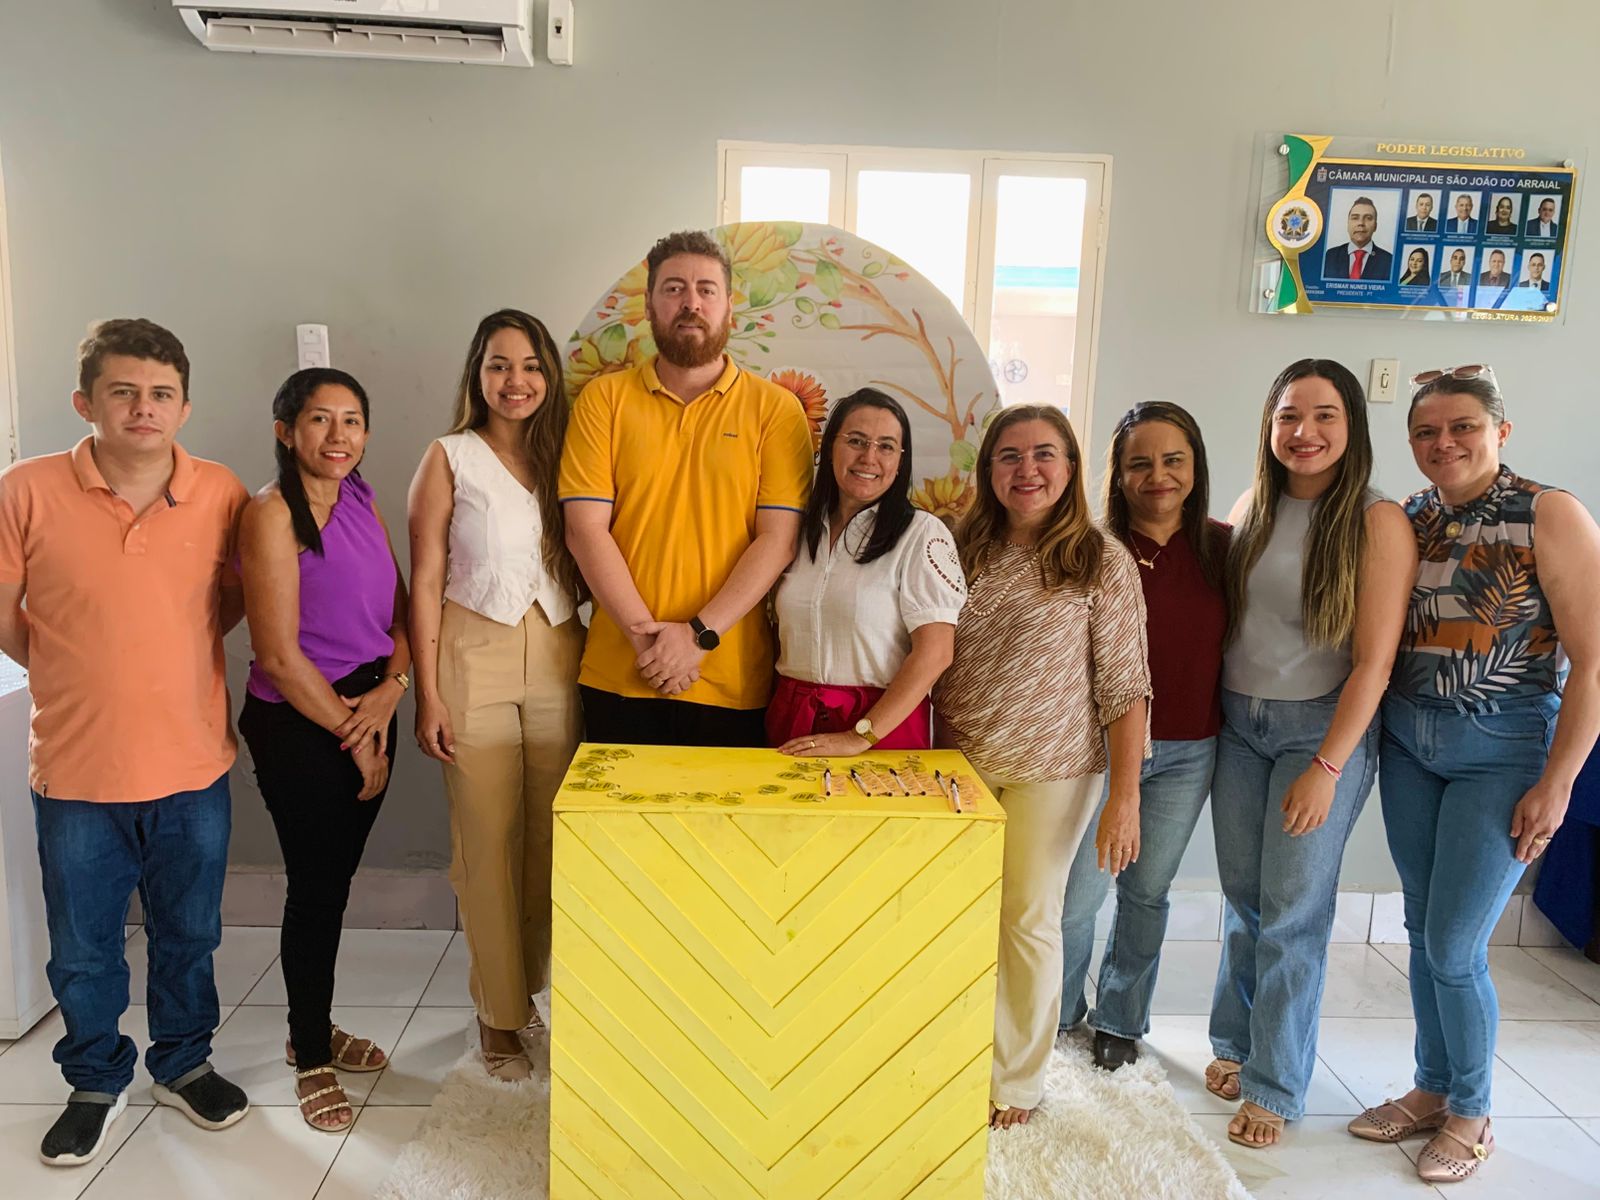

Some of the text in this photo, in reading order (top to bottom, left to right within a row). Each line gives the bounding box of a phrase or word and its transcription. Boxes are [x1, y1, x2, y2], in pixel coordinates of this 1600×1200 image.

[1376, 143, 1526, 159] PODER LEGISLATIVO
[1328, 169, 1561, 190] CÂMARA MUNICIPAL DE SÃO JOÃO DO ARRAIAL
[1471, 312, 1519, 320] LEGISLATURA
